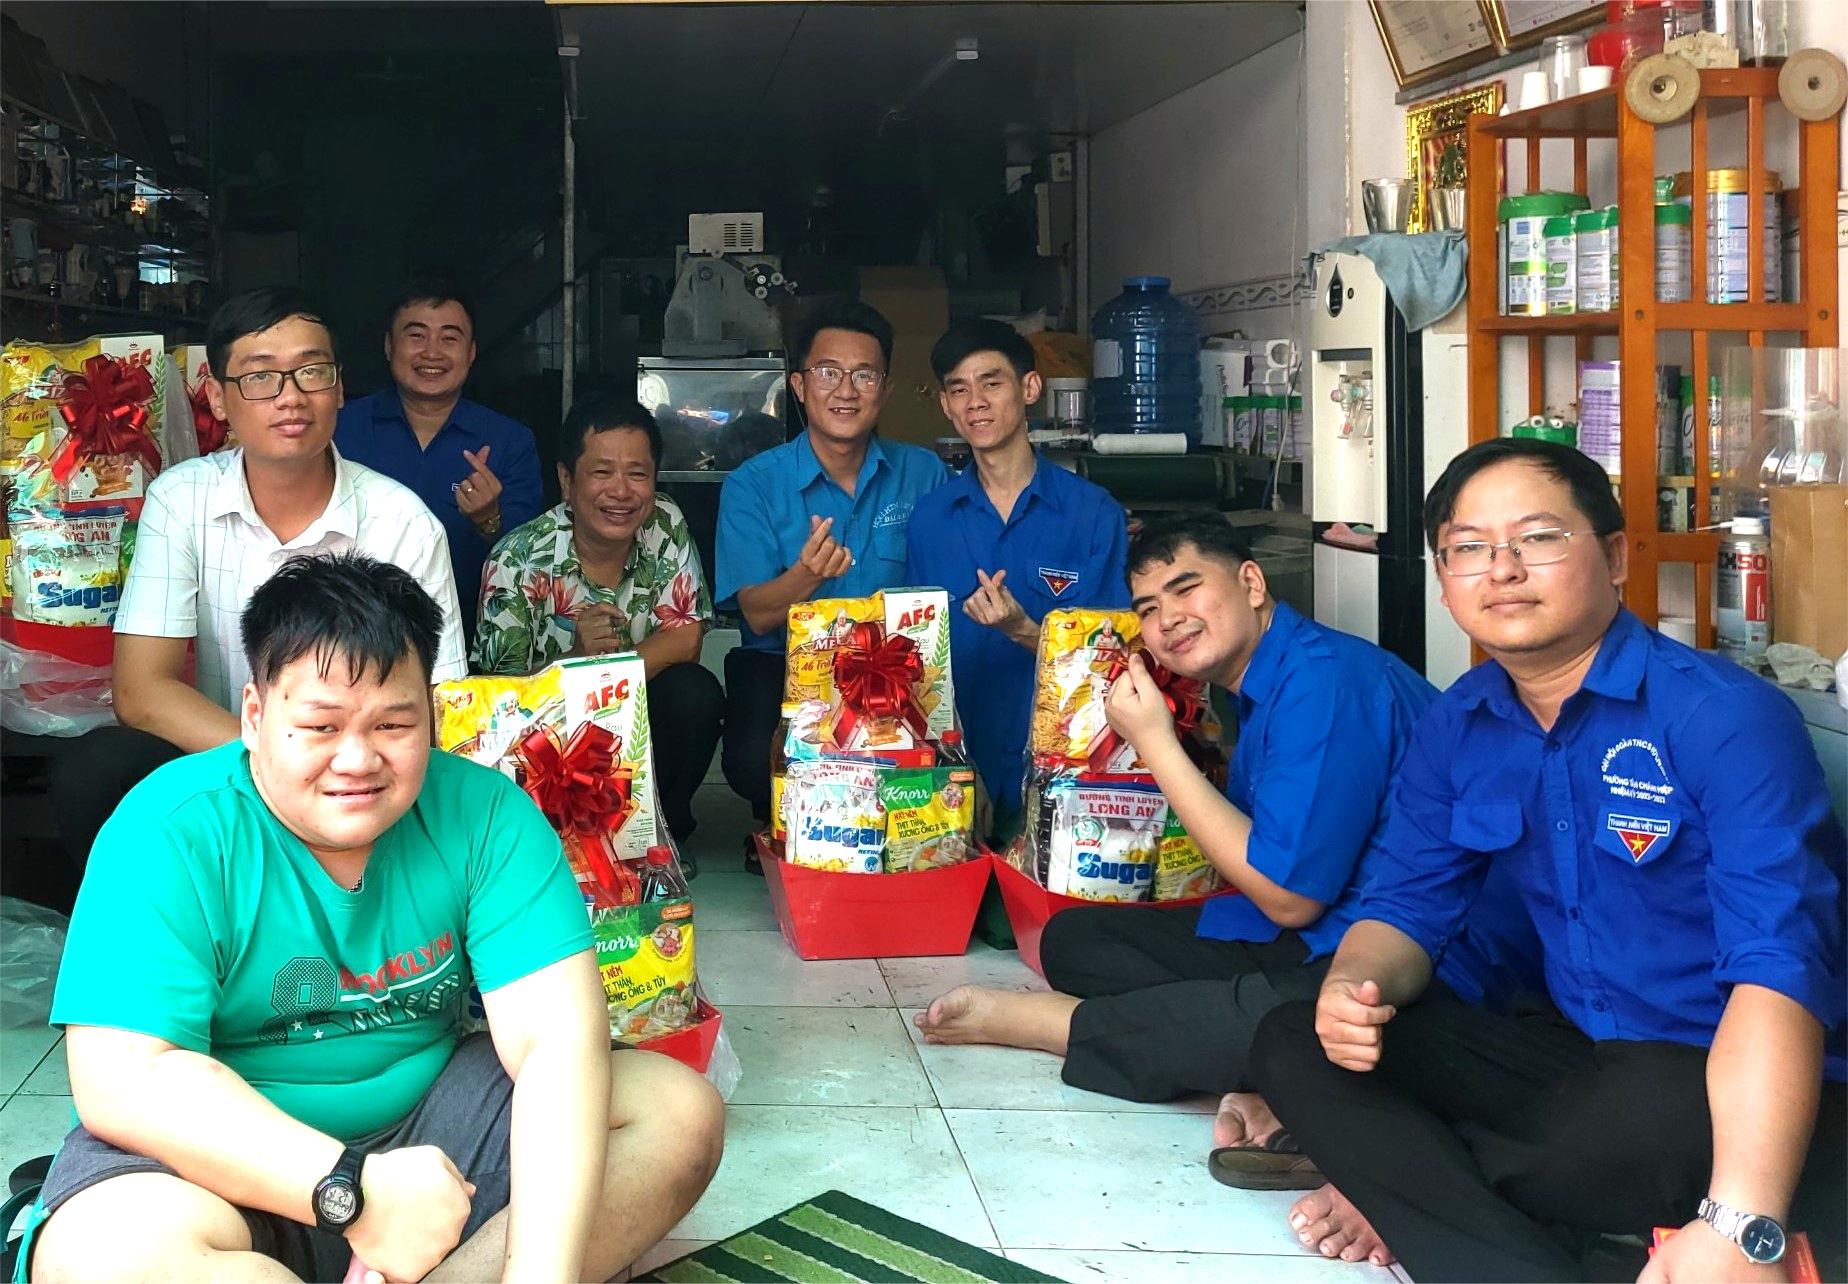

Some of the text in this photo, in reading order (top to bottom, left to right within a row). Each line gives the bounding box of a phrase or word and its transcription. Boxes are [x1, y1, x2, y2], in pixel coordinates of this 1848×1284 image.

[37, 582, 119, 609] Suga
[897, 604, 935, 630] AFC
[584, 679, 629, 714] AFC
[884, 786, 930, 802] Knorr
[1088, 803, 1155, 818] LONG AN
[1077, 852, 1151, 884] Suga
[595, 935, 637, 953] norr
[606, 965, 623, 980] NÊM
[607, 992, 627, 1003] ƠNG
[628, 984, 645, 998] ỐNG
[646, 982, 653, 991] &
